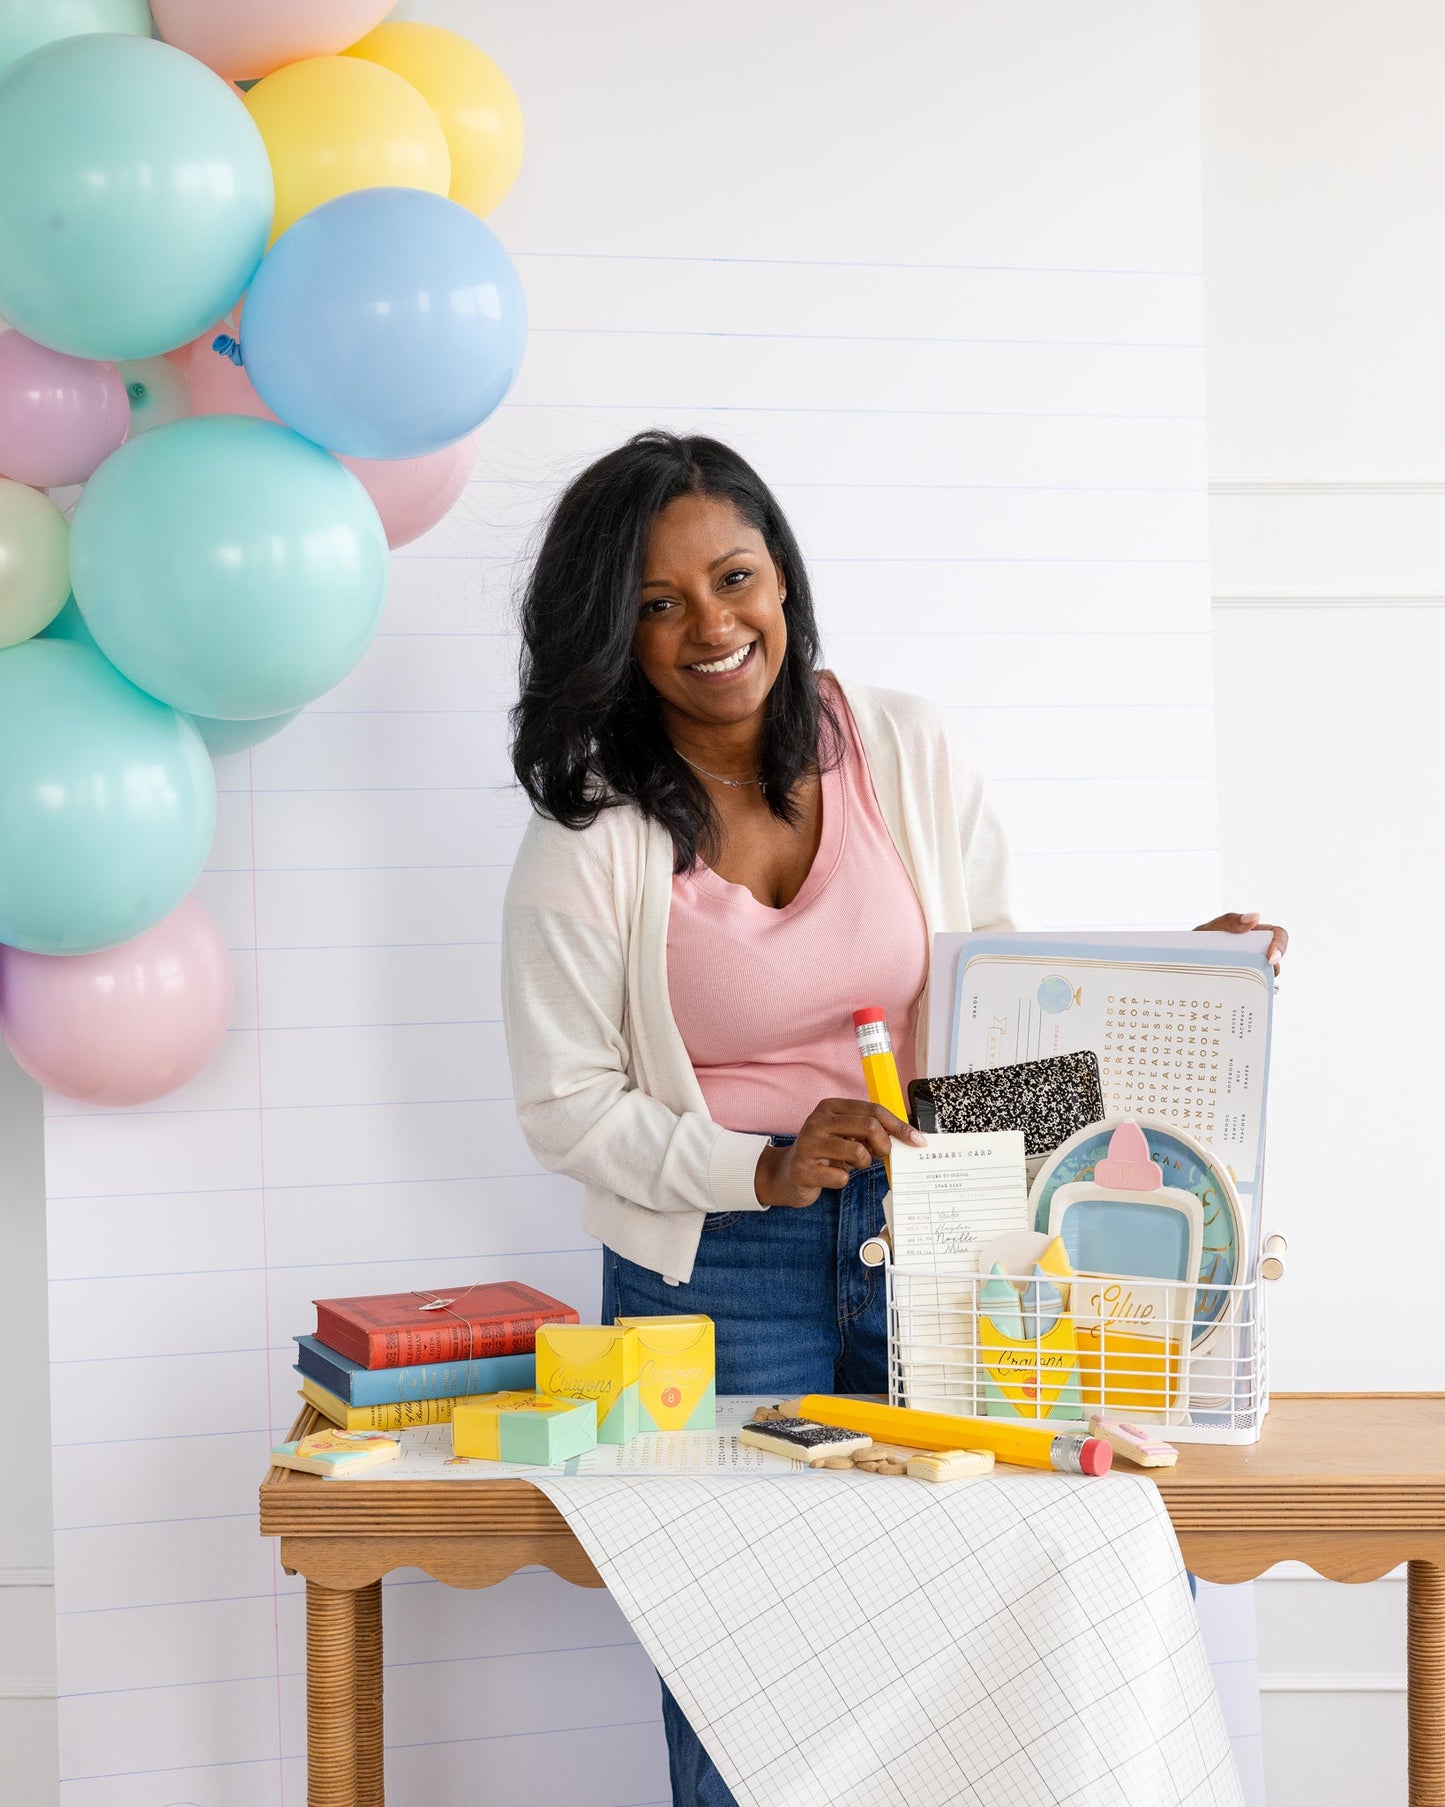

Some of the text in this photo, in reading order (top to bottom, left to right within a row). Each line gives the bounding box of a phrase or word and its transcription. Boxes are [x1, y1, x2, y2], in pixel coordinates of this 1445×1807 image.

[919, 1149, 992, 1160] LIBRARY CARD
[1152, 1152, 1183, 1171] CAN
[1090, 1284, 1156, 1338] Glue
[550, 1366, 613, 1400] Crayons
